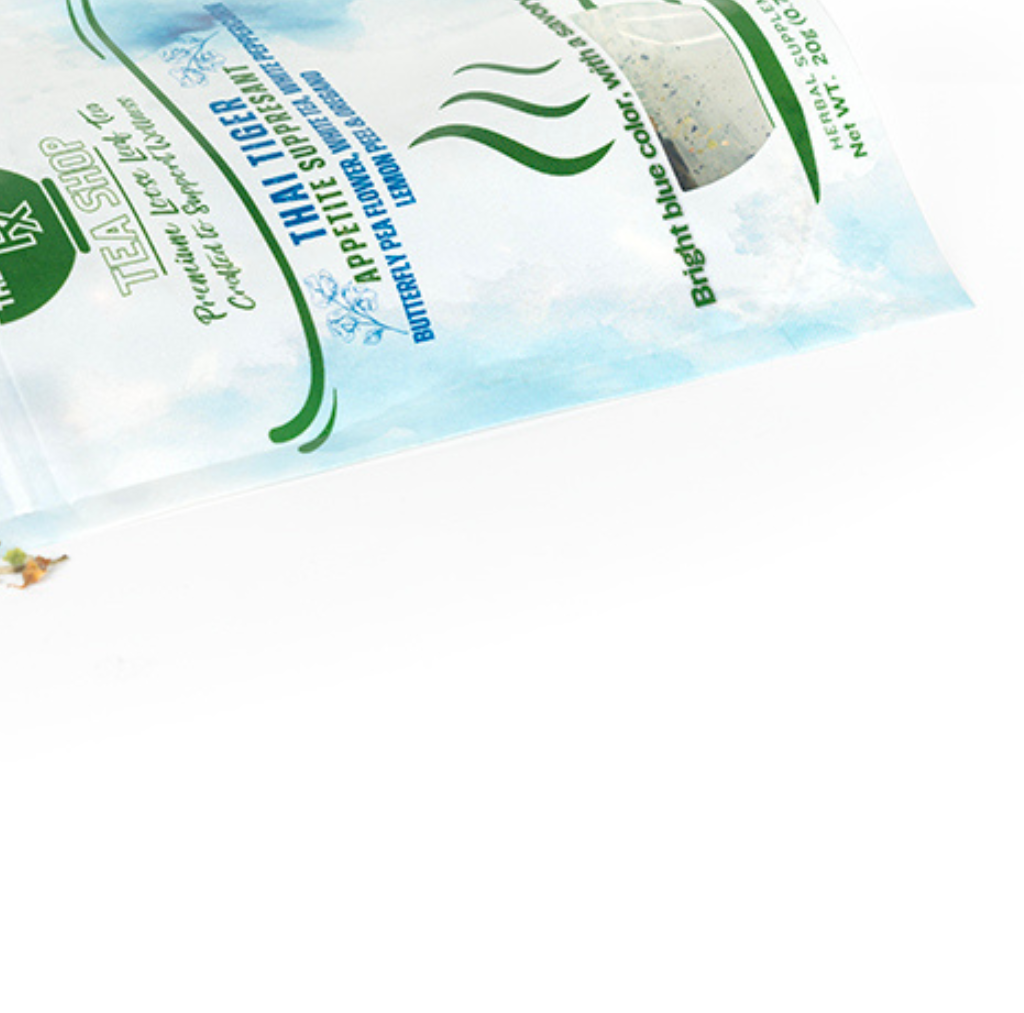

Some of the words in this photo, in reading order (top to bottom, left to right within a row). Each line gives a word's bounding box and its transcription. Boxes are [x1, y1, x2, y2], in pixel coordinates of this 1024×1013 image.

[567, 37, 588, 49] a
[579, 48, 621, 90] with
[799, 28, 829, 66] 20g
[259, 61, 302, 95] WHITE
[77, 102, 115, 130] Tea
[117, 95, 171, 151] Wellness
[208, 96, 285, 168] TIGER
[222, 64, 326, 172] SUPPRESANT
[307, 116, 352, 155] WHITE
[344, 114, 366, 128] &
[352, 124, 387, 154] PEEL
[616, 91, 657, 159] color,
[806, 73, 843, 151] HERBAL
[844, 122, 868, 158] Net
[39, 136, 121, 214] SHOP
[101, 131, 148, 162] Leaf
[132, 167, 179, 216] Loose
[150, 153, 210, 215] Support
[261, 172, 327, 246] THAI
[339, 152, 384, 218] FLOWER,
[372, 153, 417, 208] LEMON
[649, 161, 685, 221] blue
[90, 214, 159, 298] TEA
[192, 218, 219, 239] to
[309, 176, 382, 284] APPETITE
[371, 218, 398, 252] PEA
[164, 222, 227, 325] Premium
[202, 243, 256, 310] Crafted
[670, 224, 718, 308] Bright
[385, 253, 435, 344] BUTTERFLY
